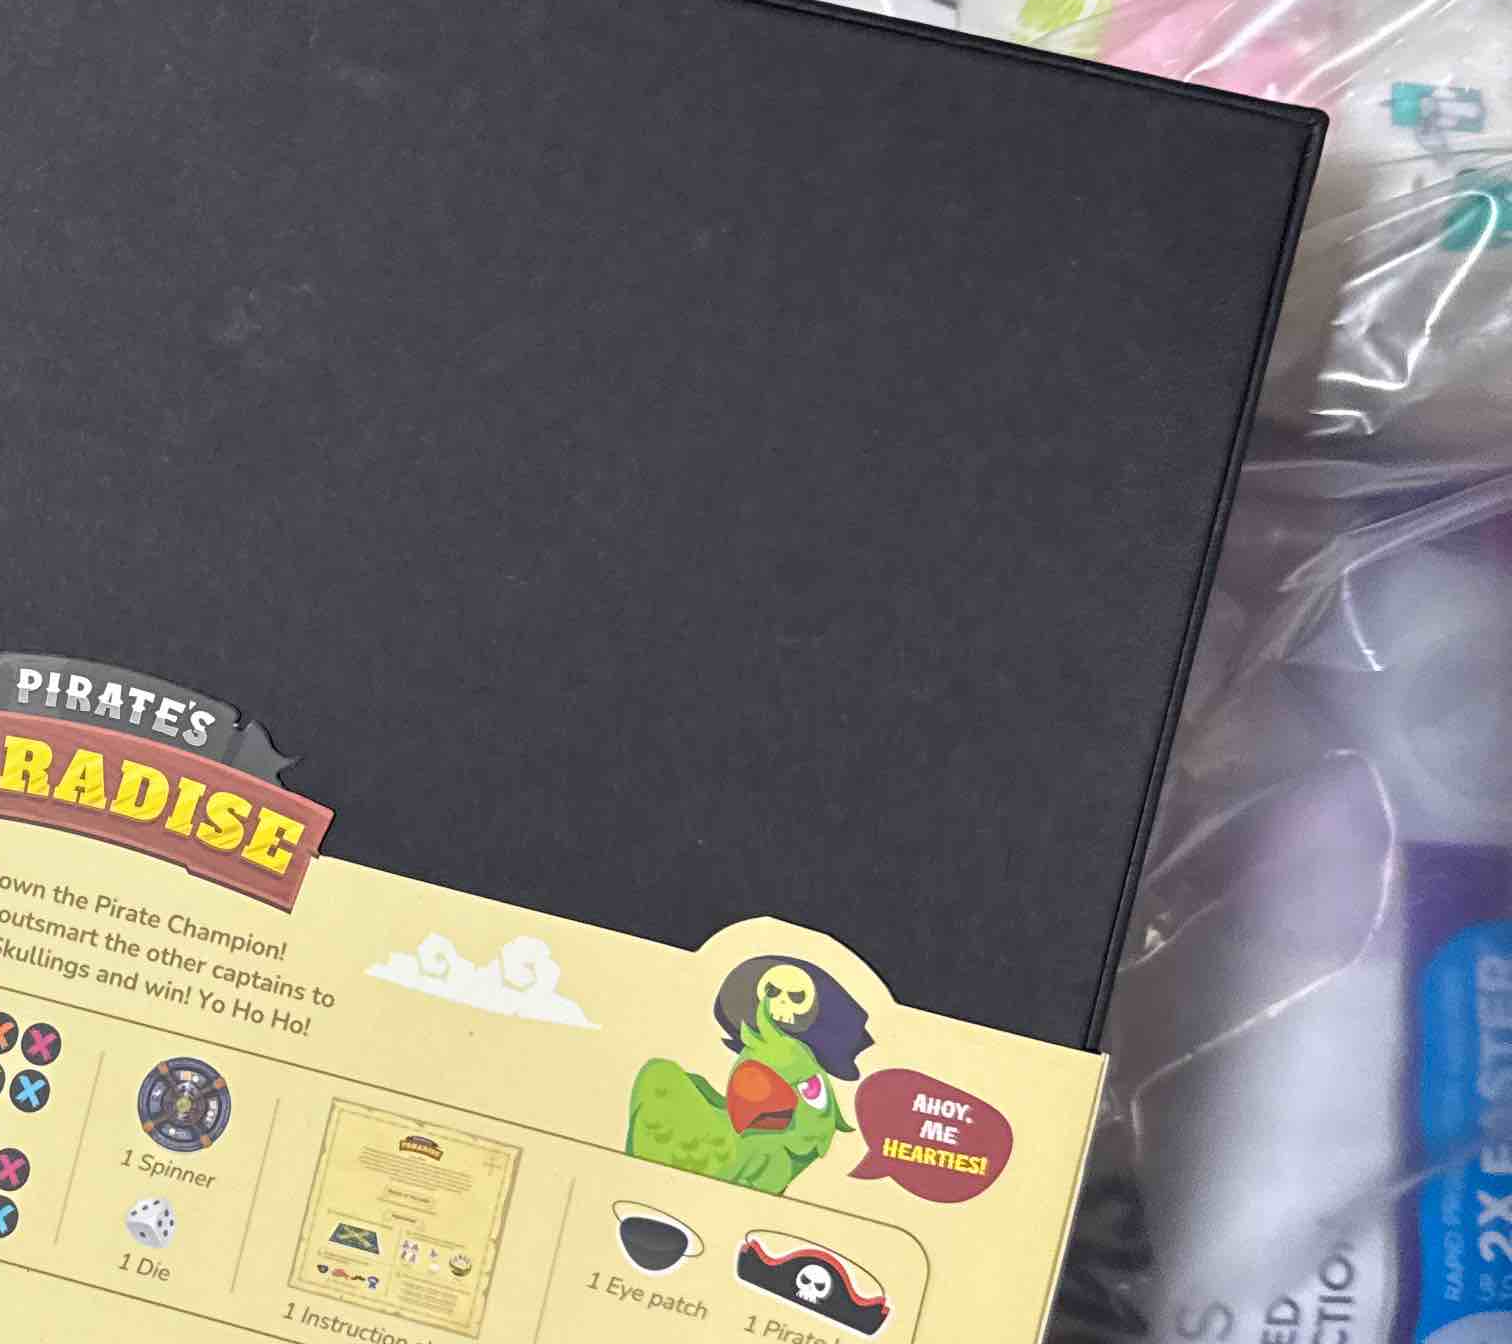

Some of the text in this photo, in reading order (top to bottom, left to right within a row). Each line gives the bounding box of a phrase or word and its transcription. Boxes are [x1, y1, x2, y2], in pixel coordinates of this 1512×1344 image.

[16, 668, 216, 748] PIRATE'S
[51, 884, 90, 911] the
[93, 893, 162, 930] Pirate
[166, 913, 289, 962] Champion!
[103, 931, 142, 959] the
[145, 946, 209, 975] other
[210, 963, 307, 1002] captains
[311, 985, 336, 1009] to
[94, 967, 141, 992] and
[144, 979, 193, 1006] win!
[198, 987, 227, 1015] Yo
[230, 997, 266, 1025] Ho
[269, 1007, 313, 1038] Ho!
[918, 1118, 961, 1146] ME
[120, 1148, 217, 1190] 1 Spinner
[881, 1136, 989, 1177] HEARTIES!
[118, 1252, 172, 1283] 1 Die
[281, 1301, 297, 1322] 1
[585, 1270, 709, 1322] 1 Eye patch
[742, 1314, 758, 1335] 1
